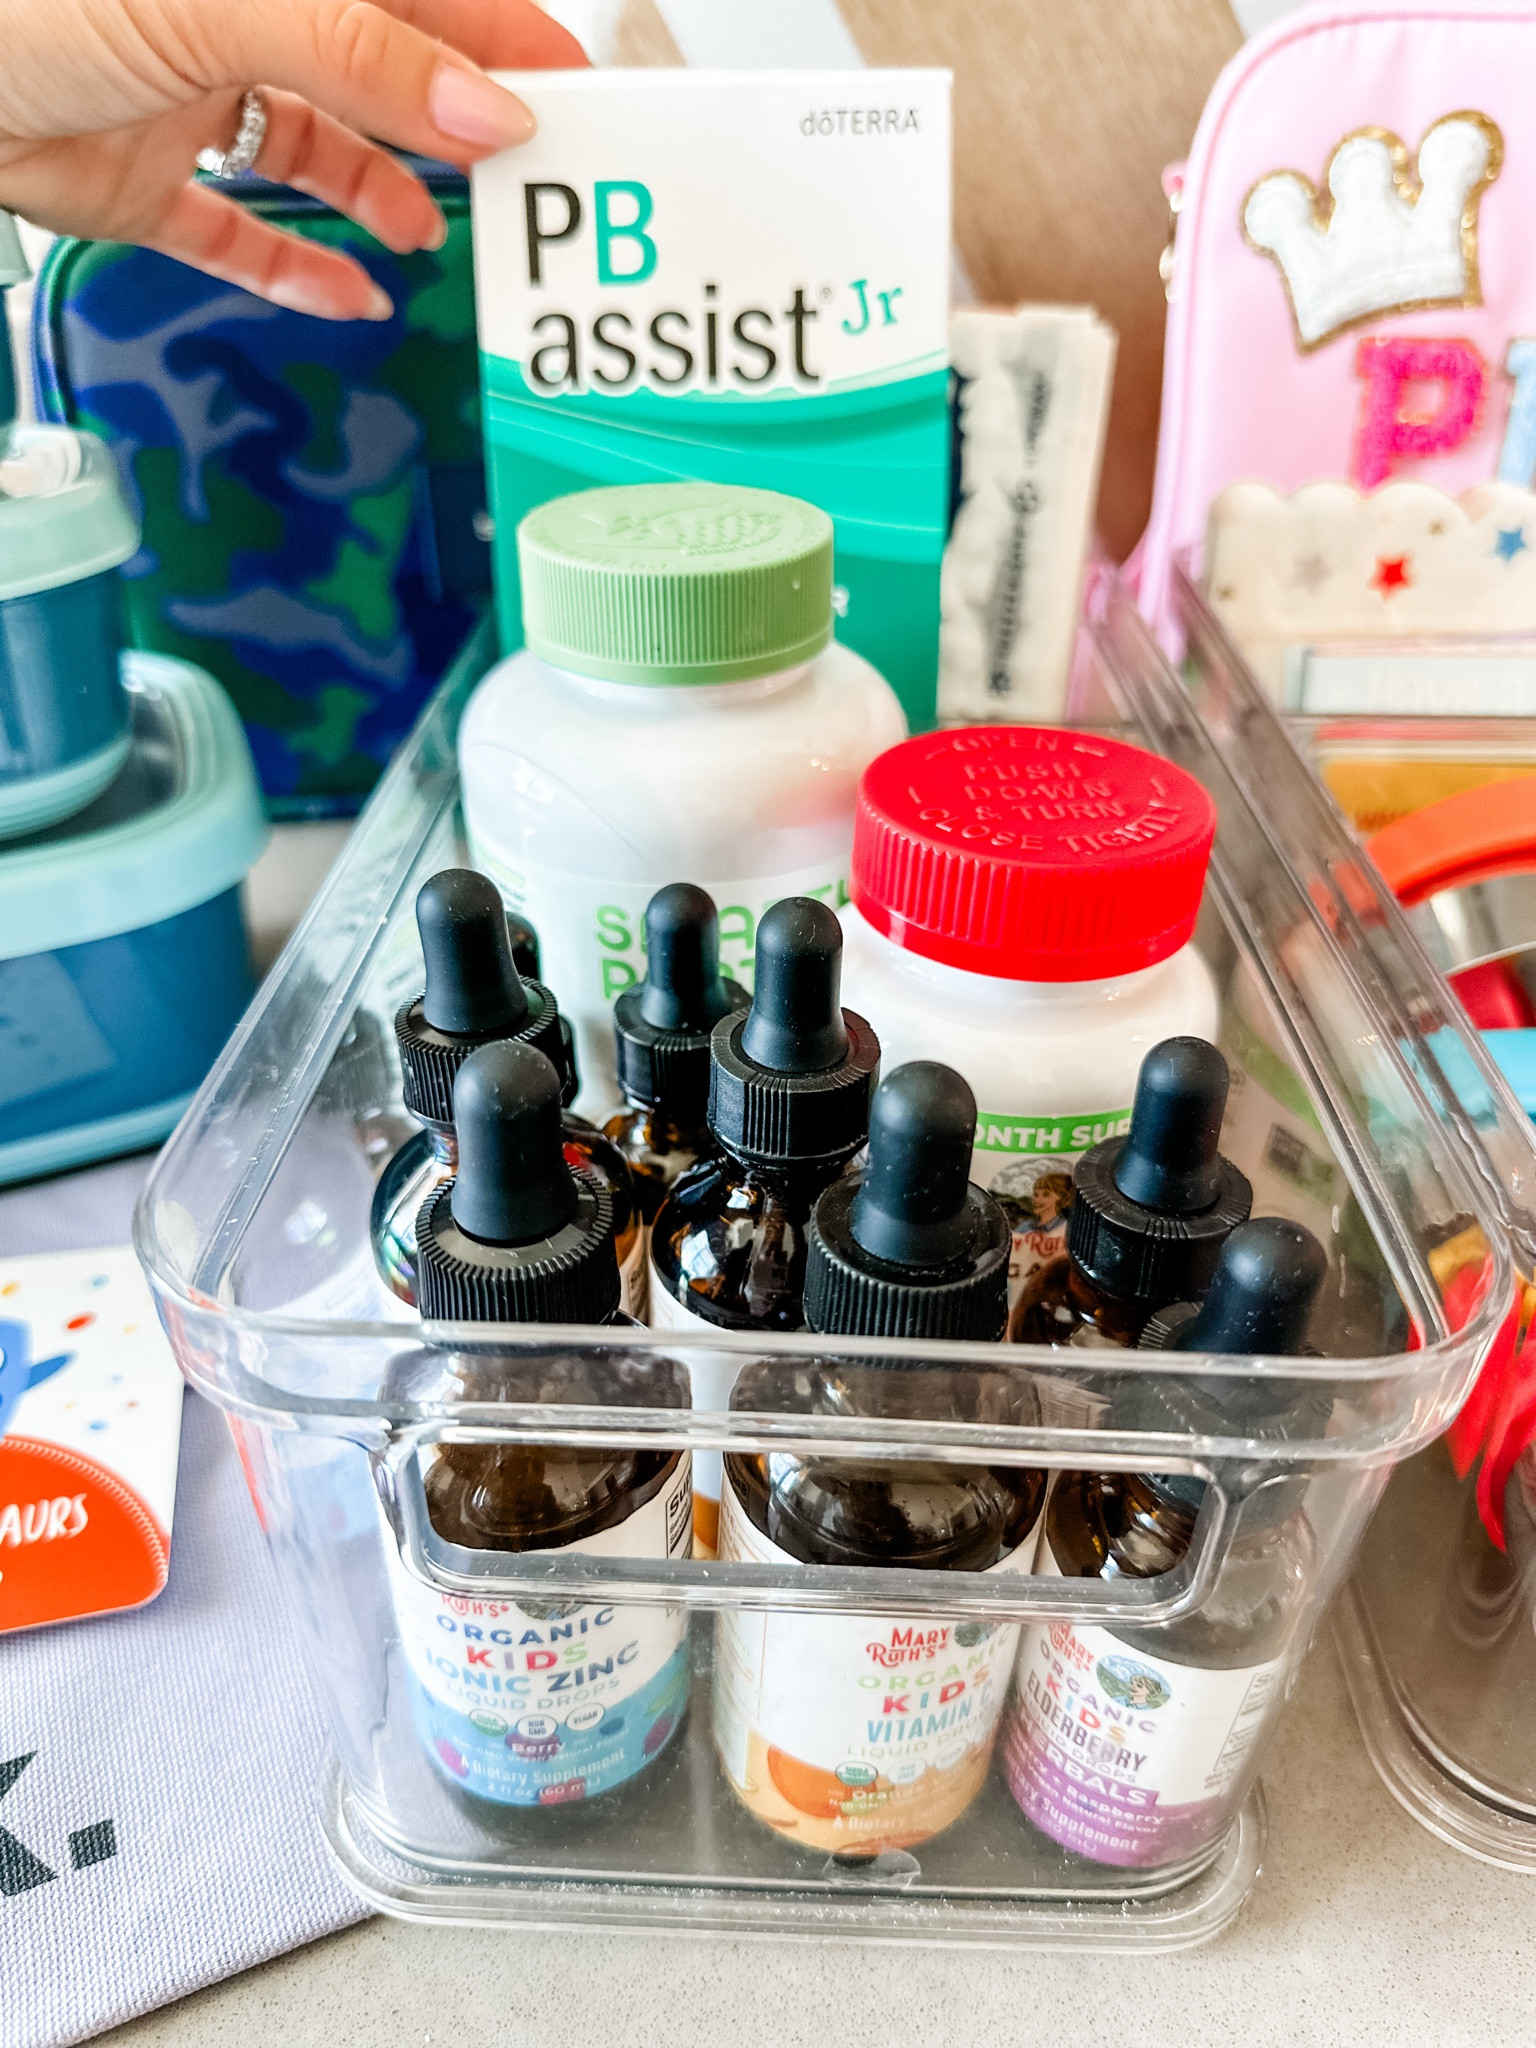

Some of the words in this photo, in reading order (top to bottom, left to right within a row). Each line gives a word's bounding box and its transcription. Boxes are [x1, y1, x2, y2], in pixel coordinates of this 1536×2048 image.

[523, 180, 659, 287] PB
[841, 279, 903, 336] Jr
[952, 732, 1058, 751] OPEN
[964, 763, 1082, 780] PUSH
[964, 783, 1112, 801] DOWN
[975, 805, 1002, 821] &
[1011, 801, 1126, 820] TURN
[919, 806, 1044, 851] CLOSE
[1057, 800, 1181, 853] TIGHTLY
[436, 1606, 615, 1645] ORGANIC
[891, 1626, 951, 1648] MARY
[426, 1647, 532, 1695] IONIC
[547, 1640, 639, 1693] ZINC
[466, 1641, 588, 1671] KIDS
[857, 1626, 1011, 1690] ORGANIC
[446, 1682, 527, 1710] LIQUID
[537, 1676, 620, 1710] DROPS
[883, 1662, 990, 1715] KIDS
[1040, 1639, 1157, 1733] ORGANIC
[867, 1695, 973, 1744] VITAMIN
[1027, 1669, 1147, 1772] ELDERBERRY
[1045, 1672, 1127, 1744] KIDS
[460, 1754, 470, 1768] A
[472, 1759, 527, 1786] Dietary
[532, 1748, 625, 1785] Supplement
[511, 1741, 566, 1755] Berry
[847, 1739, 928, 1759] LIQUID
[1072, 1748, 1138, 1784] DROPS
[1042, 1797, 1140, 1851] Supplement
[1066, 1784, 1164, 1826] Raspberry
